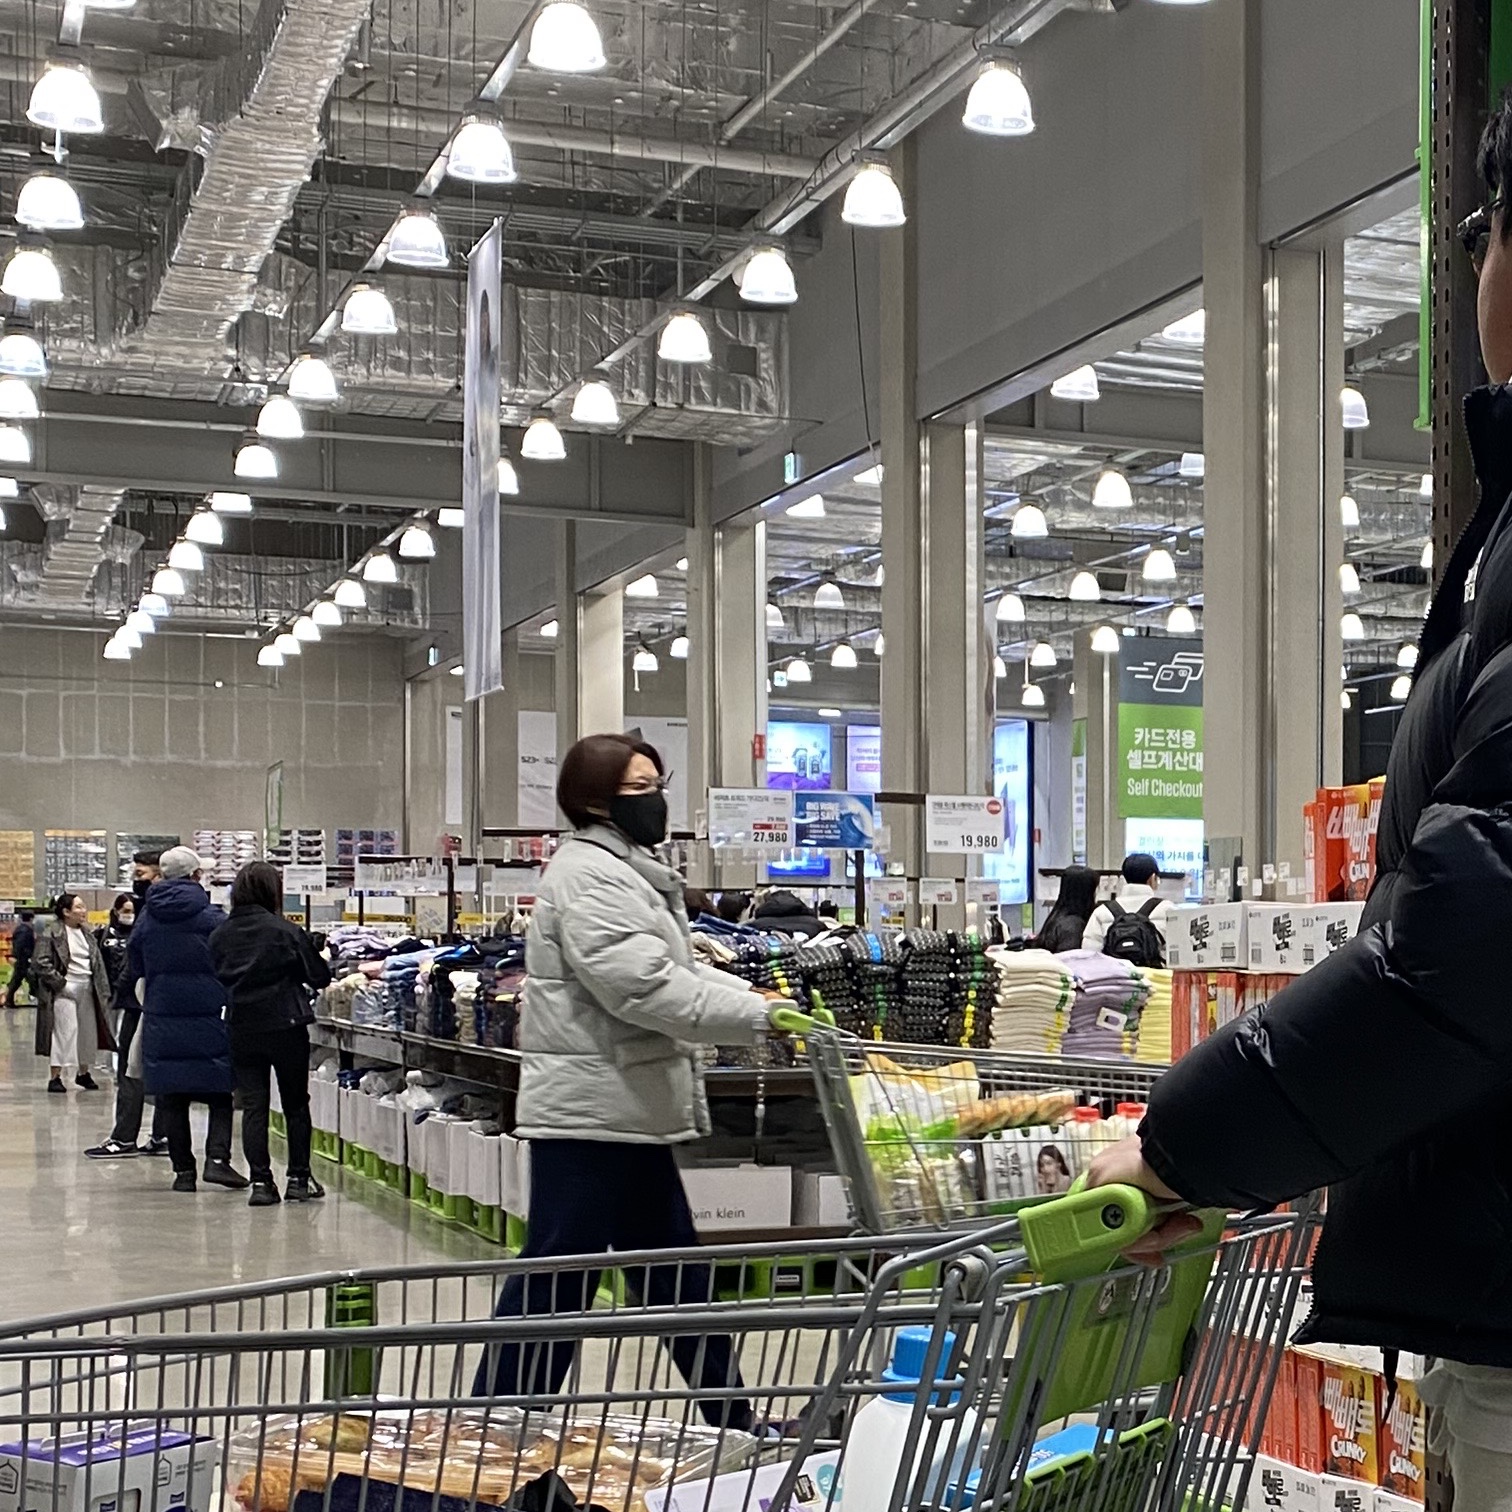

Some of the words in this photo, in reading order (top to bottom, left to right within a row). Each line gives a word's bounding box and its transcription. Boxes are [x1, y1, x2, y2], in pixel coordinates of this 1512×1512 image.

[1134, 727, 1197, 750] 카드전용
[1126, 749, 1203, 772] 셀프계산대
[1127, 778, 1150, 797] Self
[1151, 779, 1203, 798] Checkout
[753, 831, 789, 844] 27,980
[960, 835, 999, 848] 19,980
[716, 1207, 746, 1219] klein
